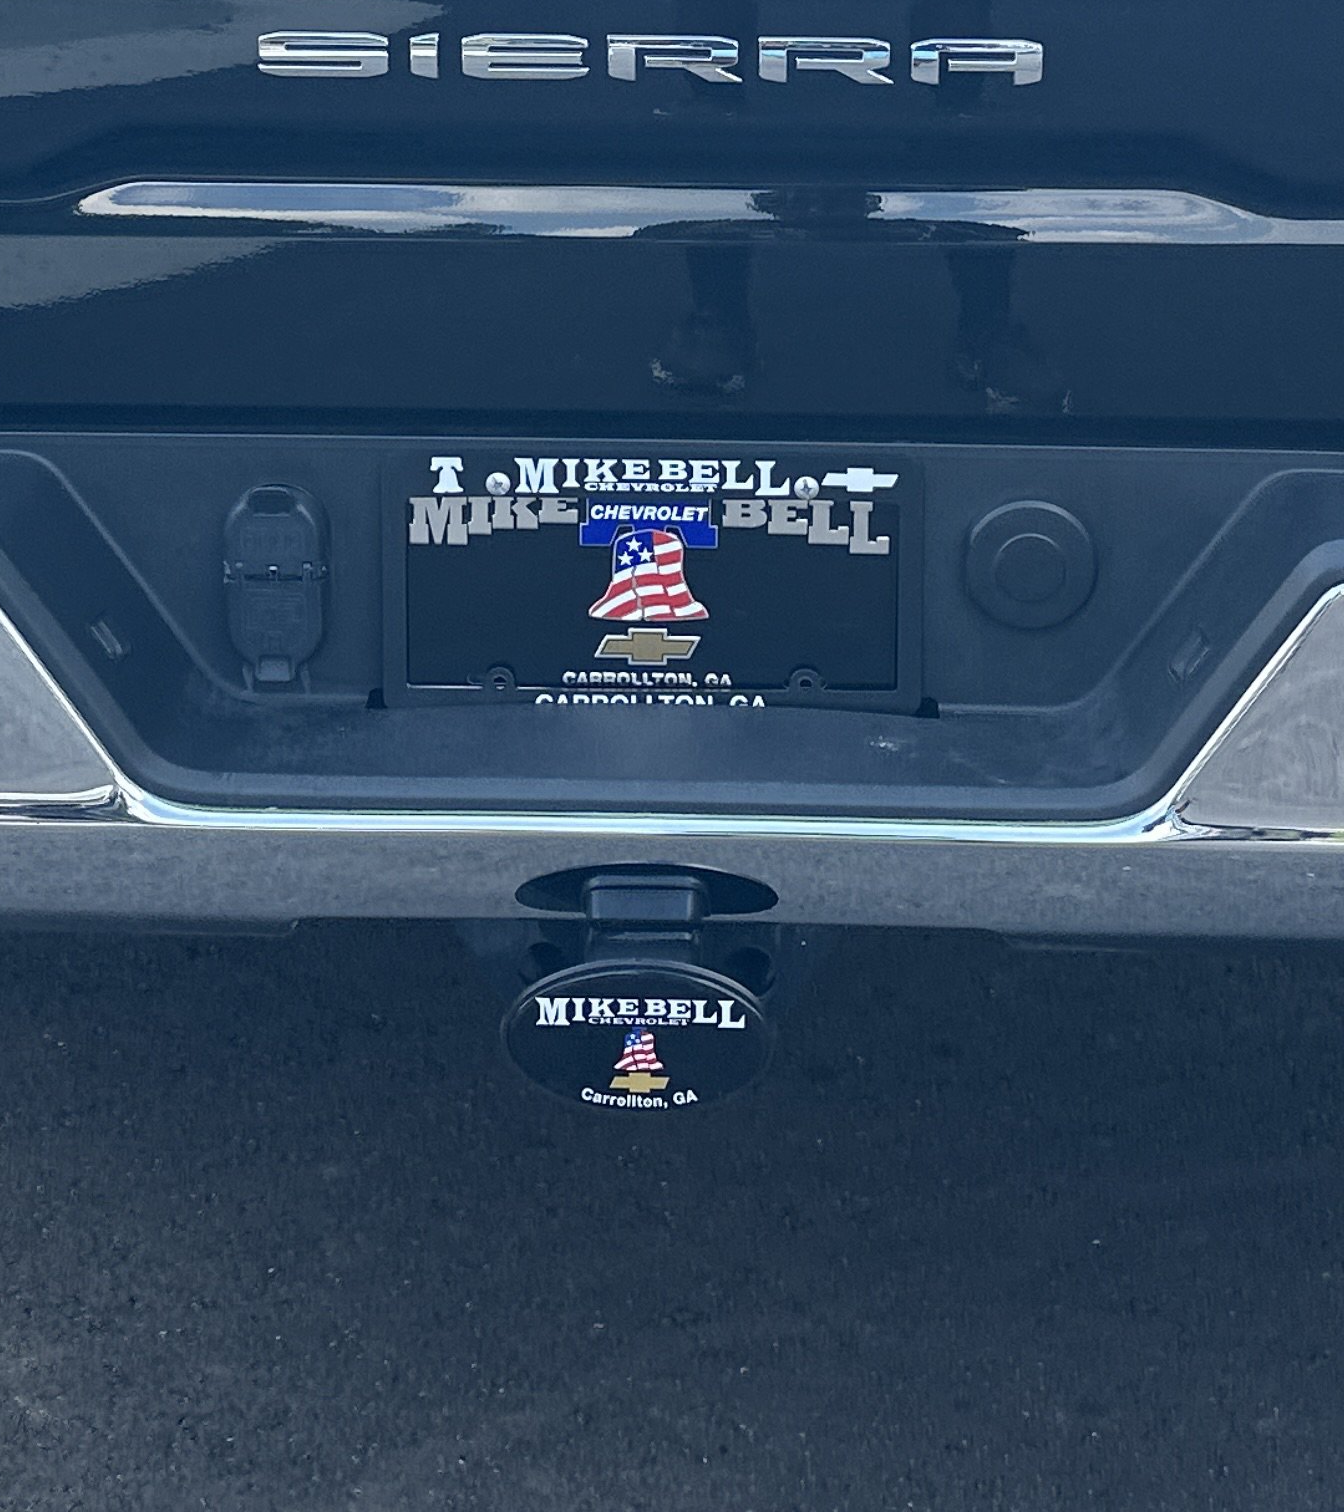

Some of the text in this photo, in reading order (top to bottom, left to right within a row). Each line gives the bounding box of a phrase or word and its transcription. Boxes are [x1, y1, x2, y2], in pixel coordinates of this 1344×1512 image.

[257, 31, 1044, 86] SIERRA
[514, 457, 790, 496] MIKE BELL
[584, 482, 717, 493] CHEVROLET
[590, 504, 709, 522] CHEVROLET
[409, 497, 890, 554] MIKE BELL
[704, 672, 732, 686] GA
[535, 996, 746, 1029] MIKE BELL
[588, 1017, 690, 1027] CHEVROLET
[581, 1087, 698, 1109] Carrollton, GA
